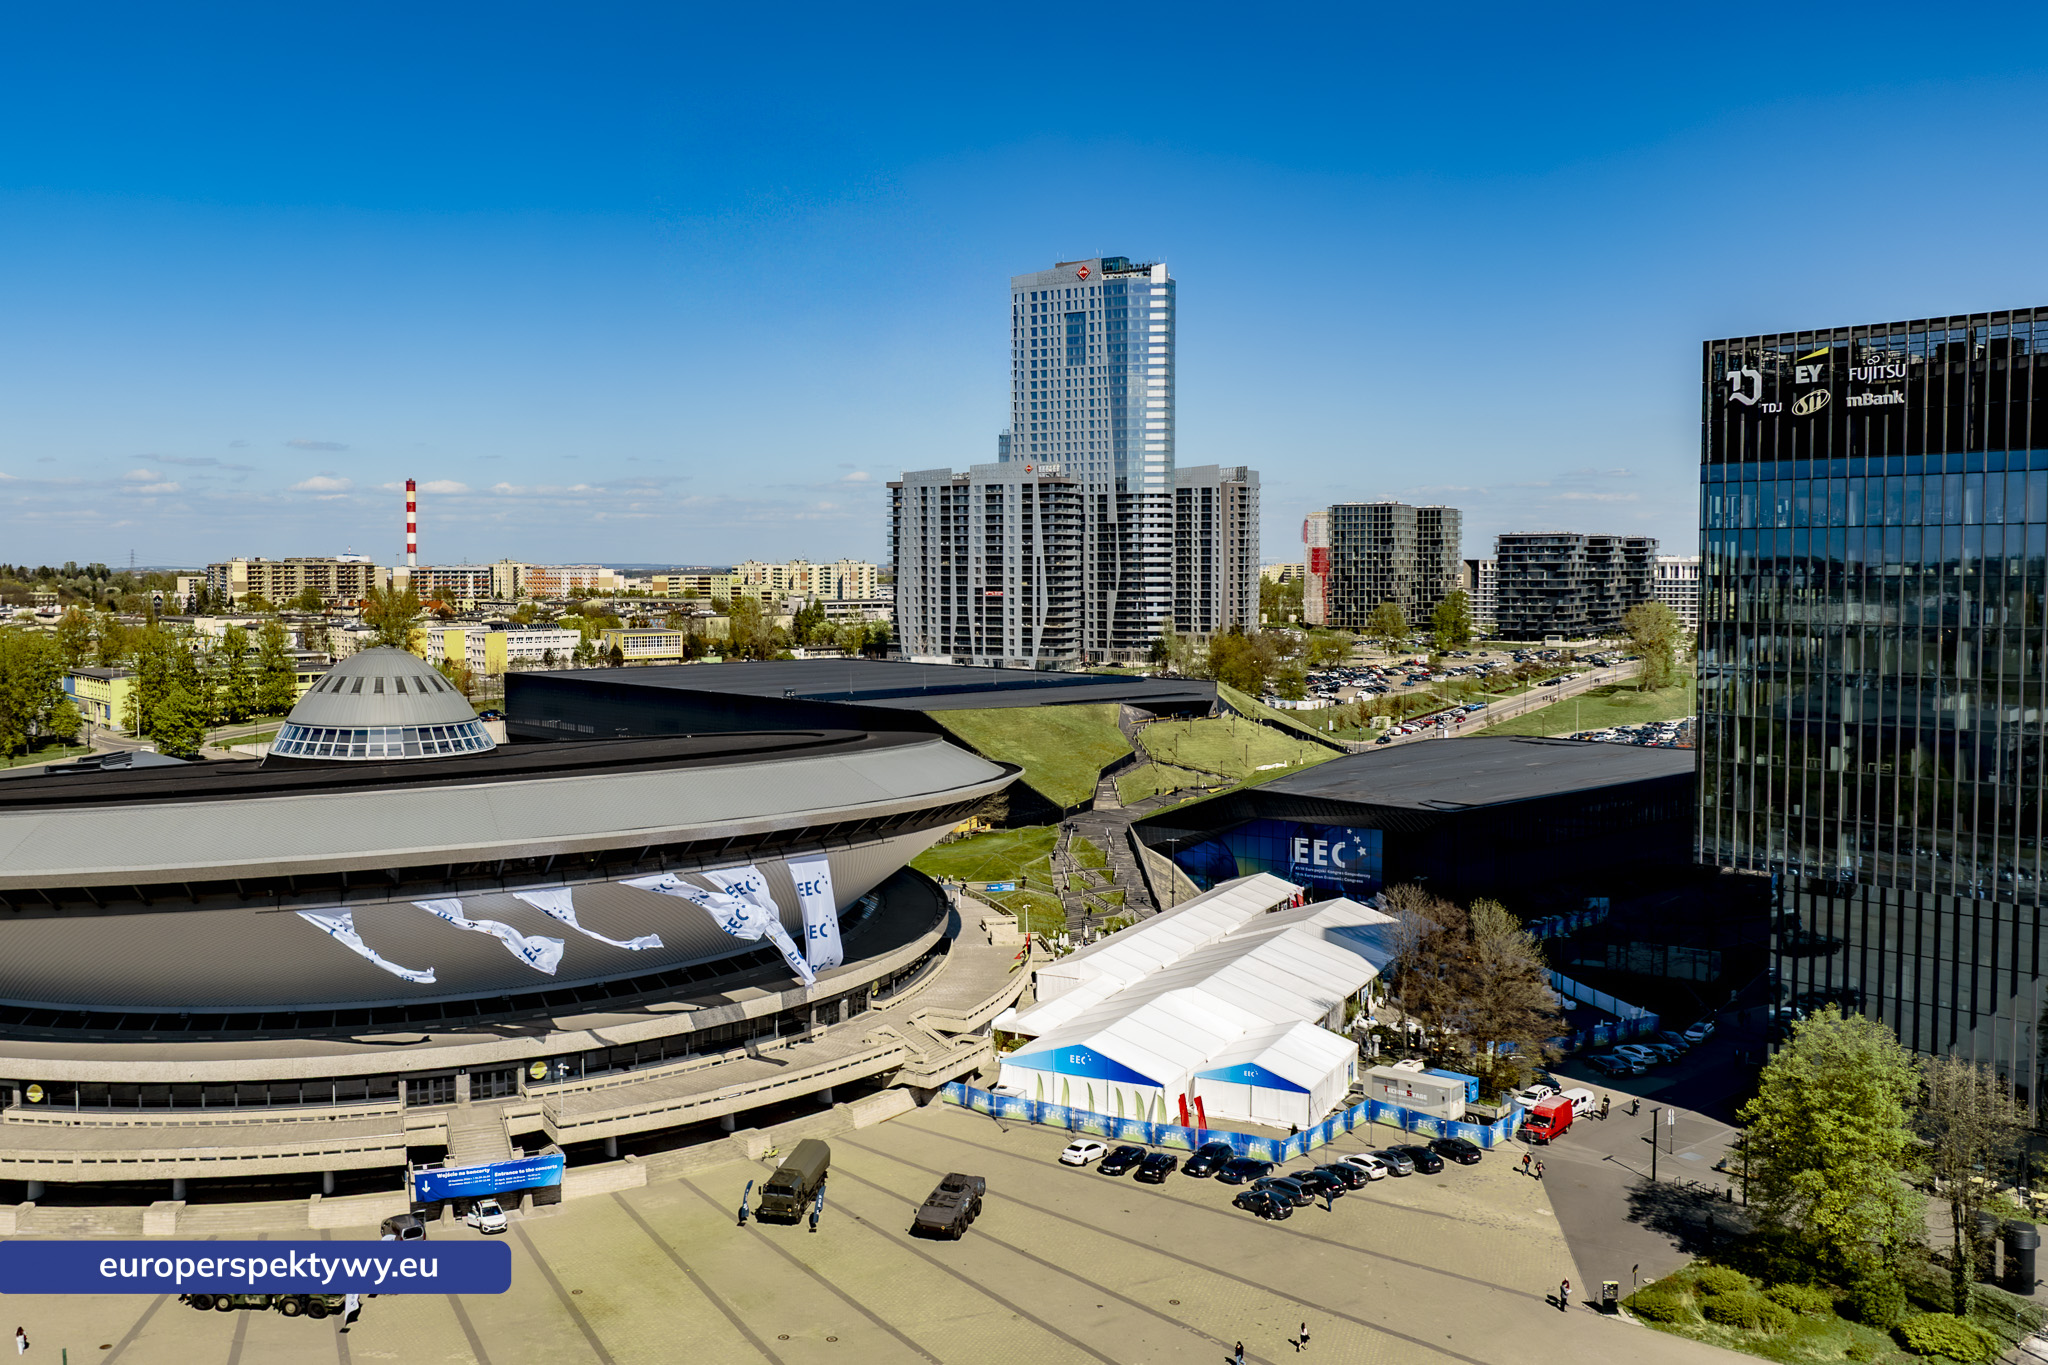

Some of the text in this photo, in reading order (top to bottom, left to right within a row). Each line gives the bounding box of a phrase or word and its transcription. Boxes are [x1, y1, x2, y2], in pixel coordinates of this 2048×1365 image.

[1795, 363, 1824, 384] EY
[1849, 363, 1907, 384] FUJITSU
[1846, 390, 1905, 407] mBank
[1761, 402, 1783, 414] TDJ
[1294, 837, 1346, 868] EEC
[797, 880, 821, 897] EEC
[1069, 1054, 1086, 1065] EEC
[1045, 1109, 1061, 1120] EEC
[1379, 1108, 1395, 1120] EEC
[1417, 1118, 1434, 1130] EEC
[1123, 1125, 1139, 1136] EEC
[1165, 1131, 1182, 1142] EEC
[1457, 1129, 1475, 1140] EEC
[1249, 1142, 1266, 1154] EEC
